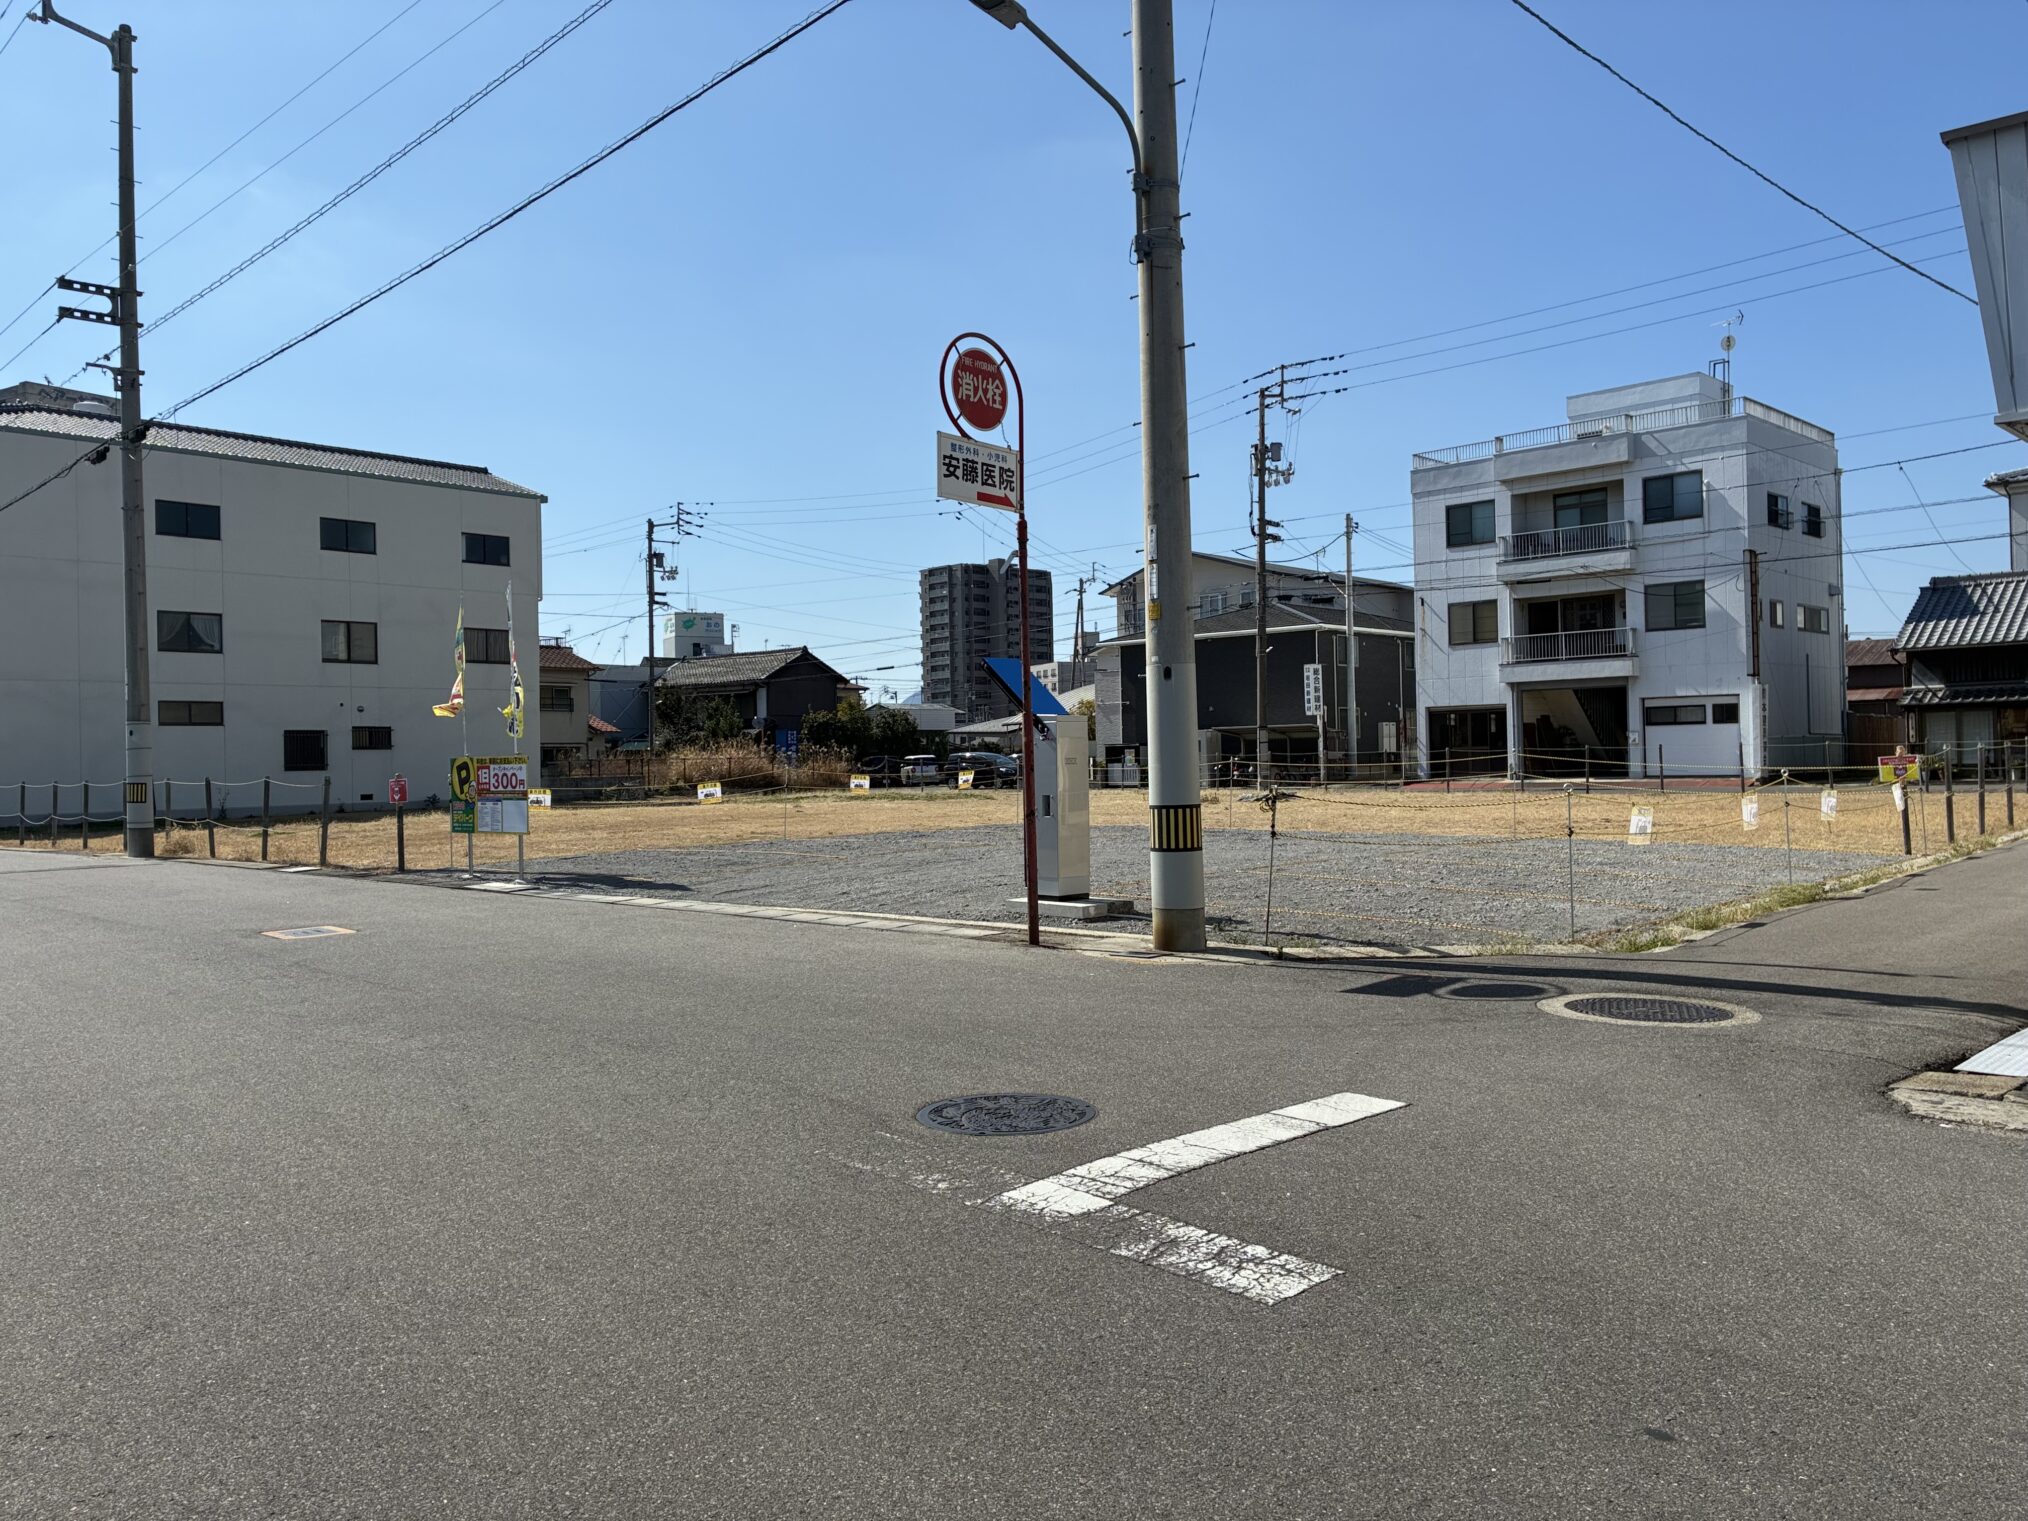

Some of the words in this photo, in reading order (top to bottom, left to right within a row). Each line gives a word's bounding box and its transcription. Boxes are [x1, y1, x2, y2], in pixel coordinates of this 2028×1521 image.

[961, 355, 974, 367] FIRE
[975, 360, 998, 374] HYDRANT
[957, 369, 1003, 410] 消火栓
[942, 454, 1015, 492] 安藤医院
[456, 761, 470, 795] P
[477, 769, 490, 784] 1日
[492, 772, 525, 790] 300円
